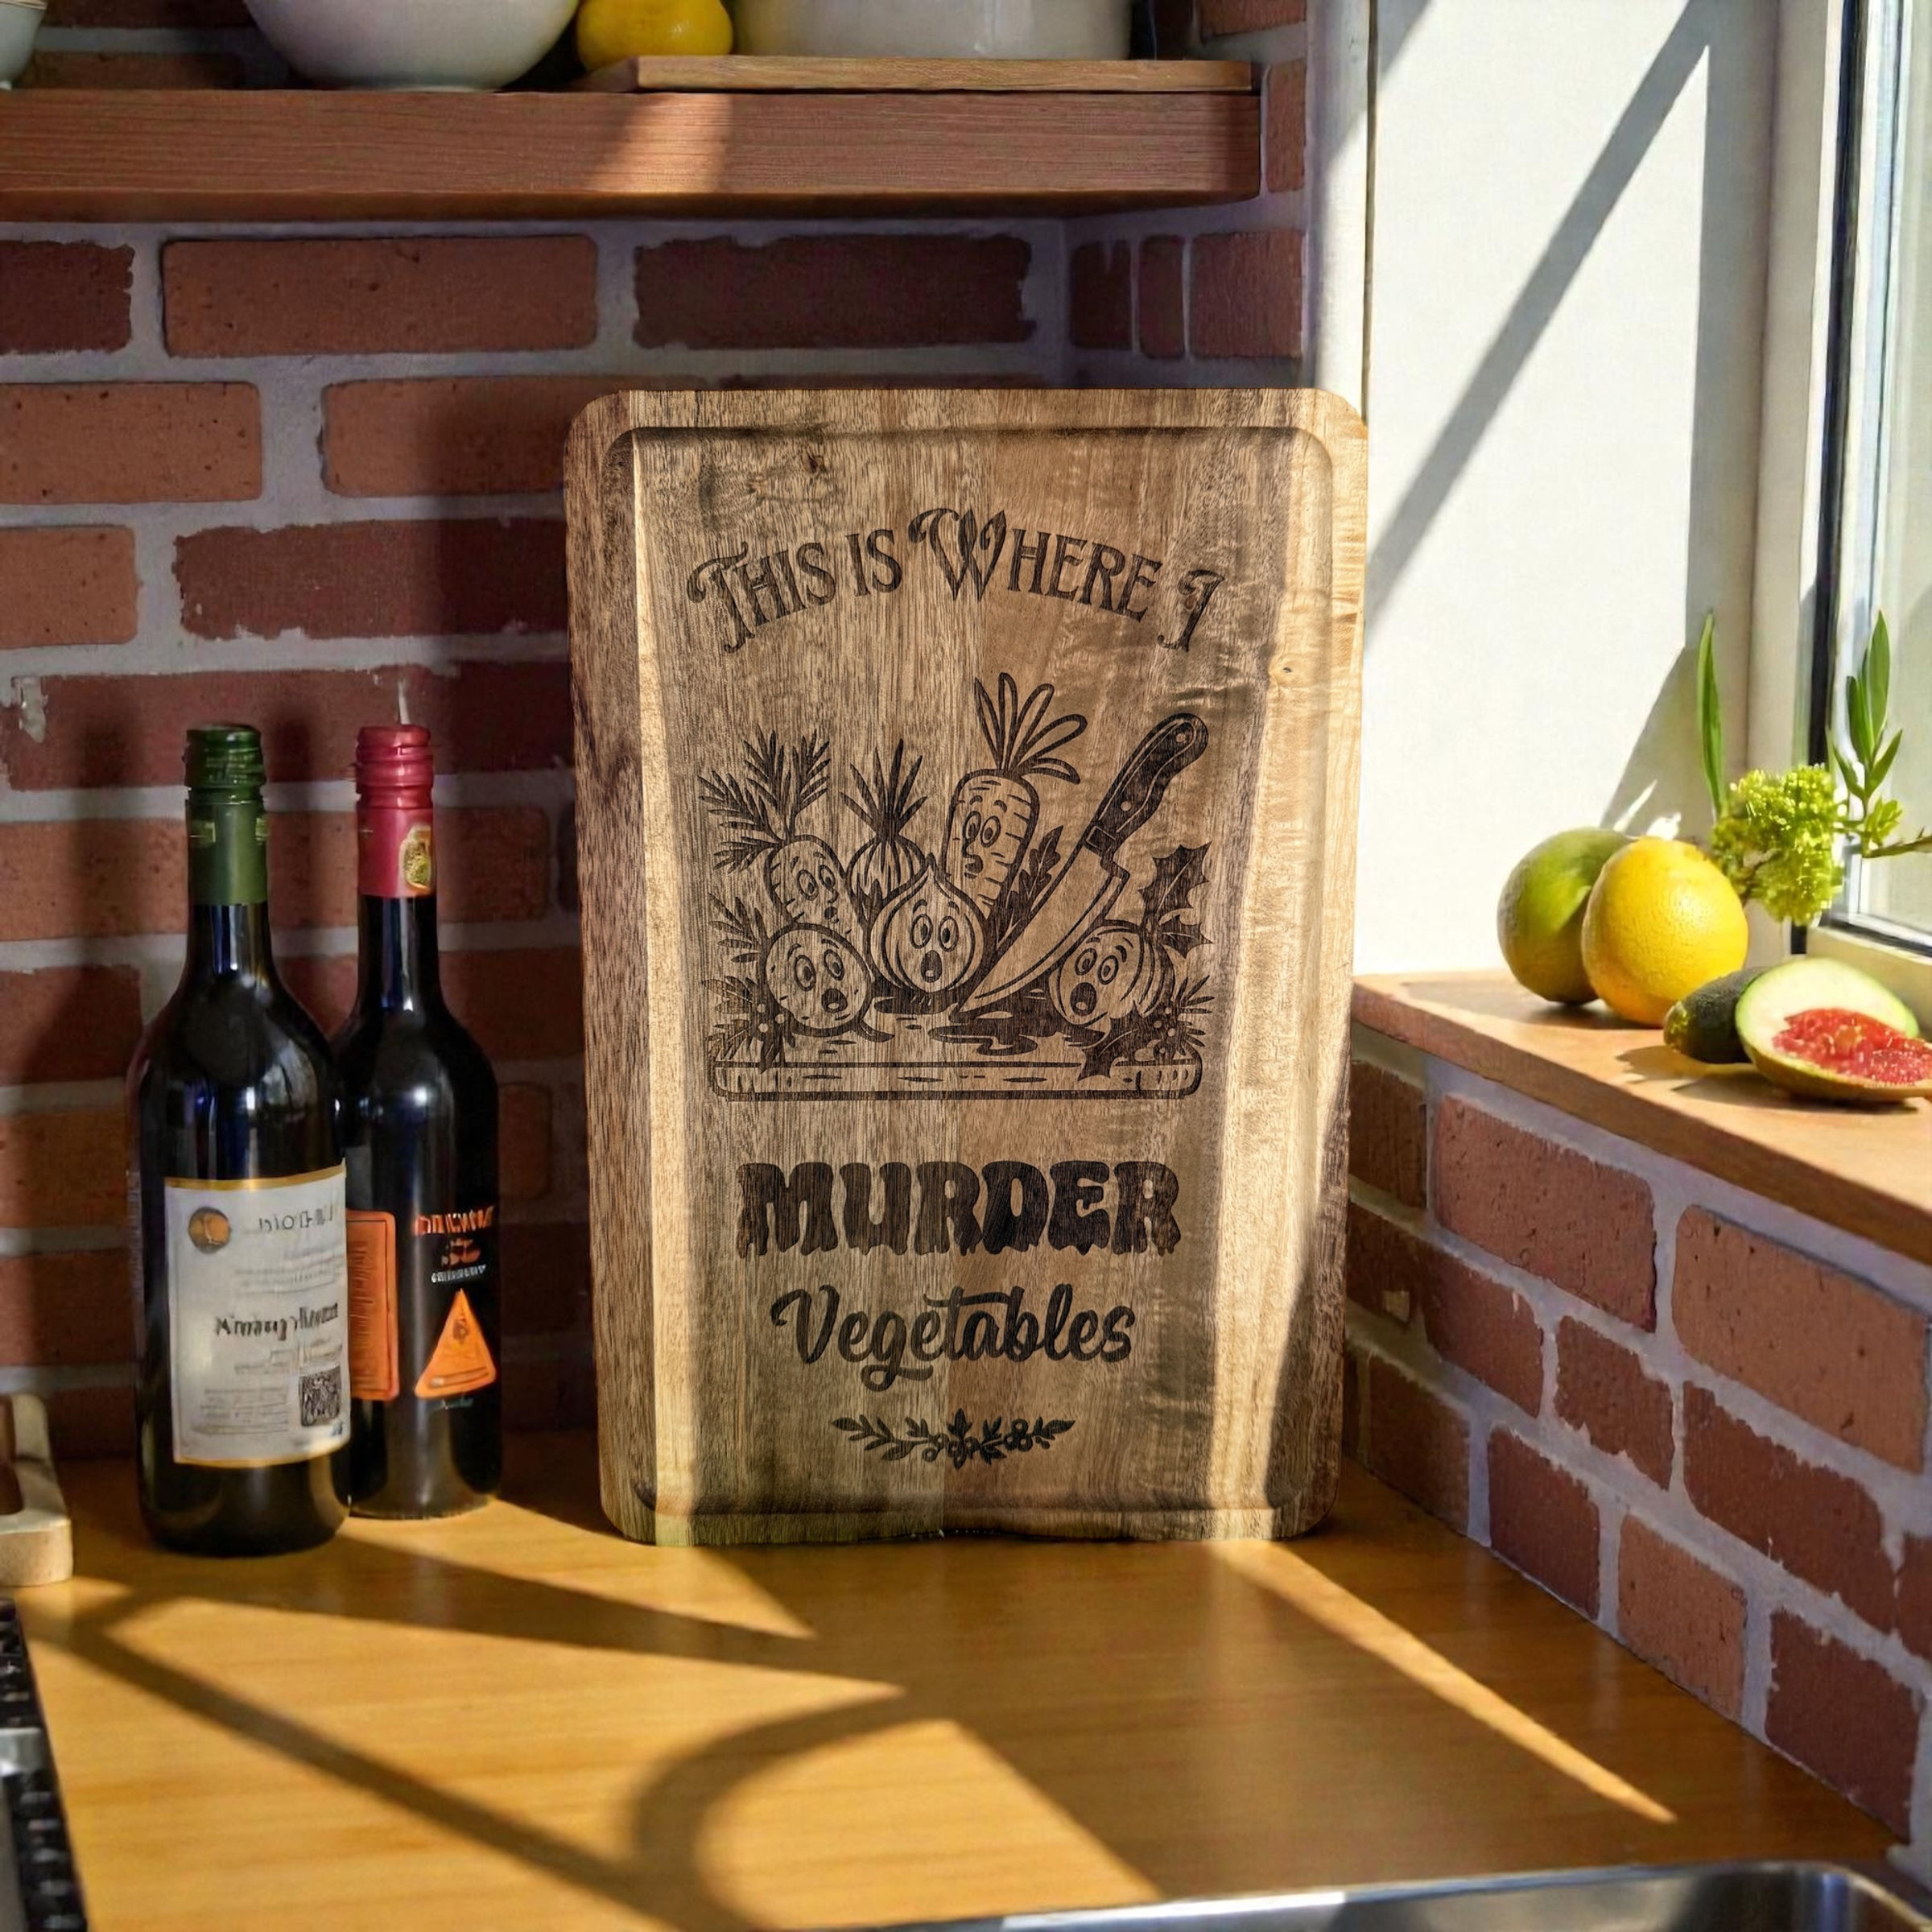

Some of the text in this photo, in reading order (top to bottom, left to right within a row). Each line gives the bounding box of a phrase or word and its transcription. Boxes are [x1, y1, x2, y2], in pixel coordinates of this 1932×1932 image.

[687, 508, 1224, 654] THIS IS WHERE I
[736, 1160, 1181, 1258] MURDER
[770, 1284, 1136, 1392] Vegetables
